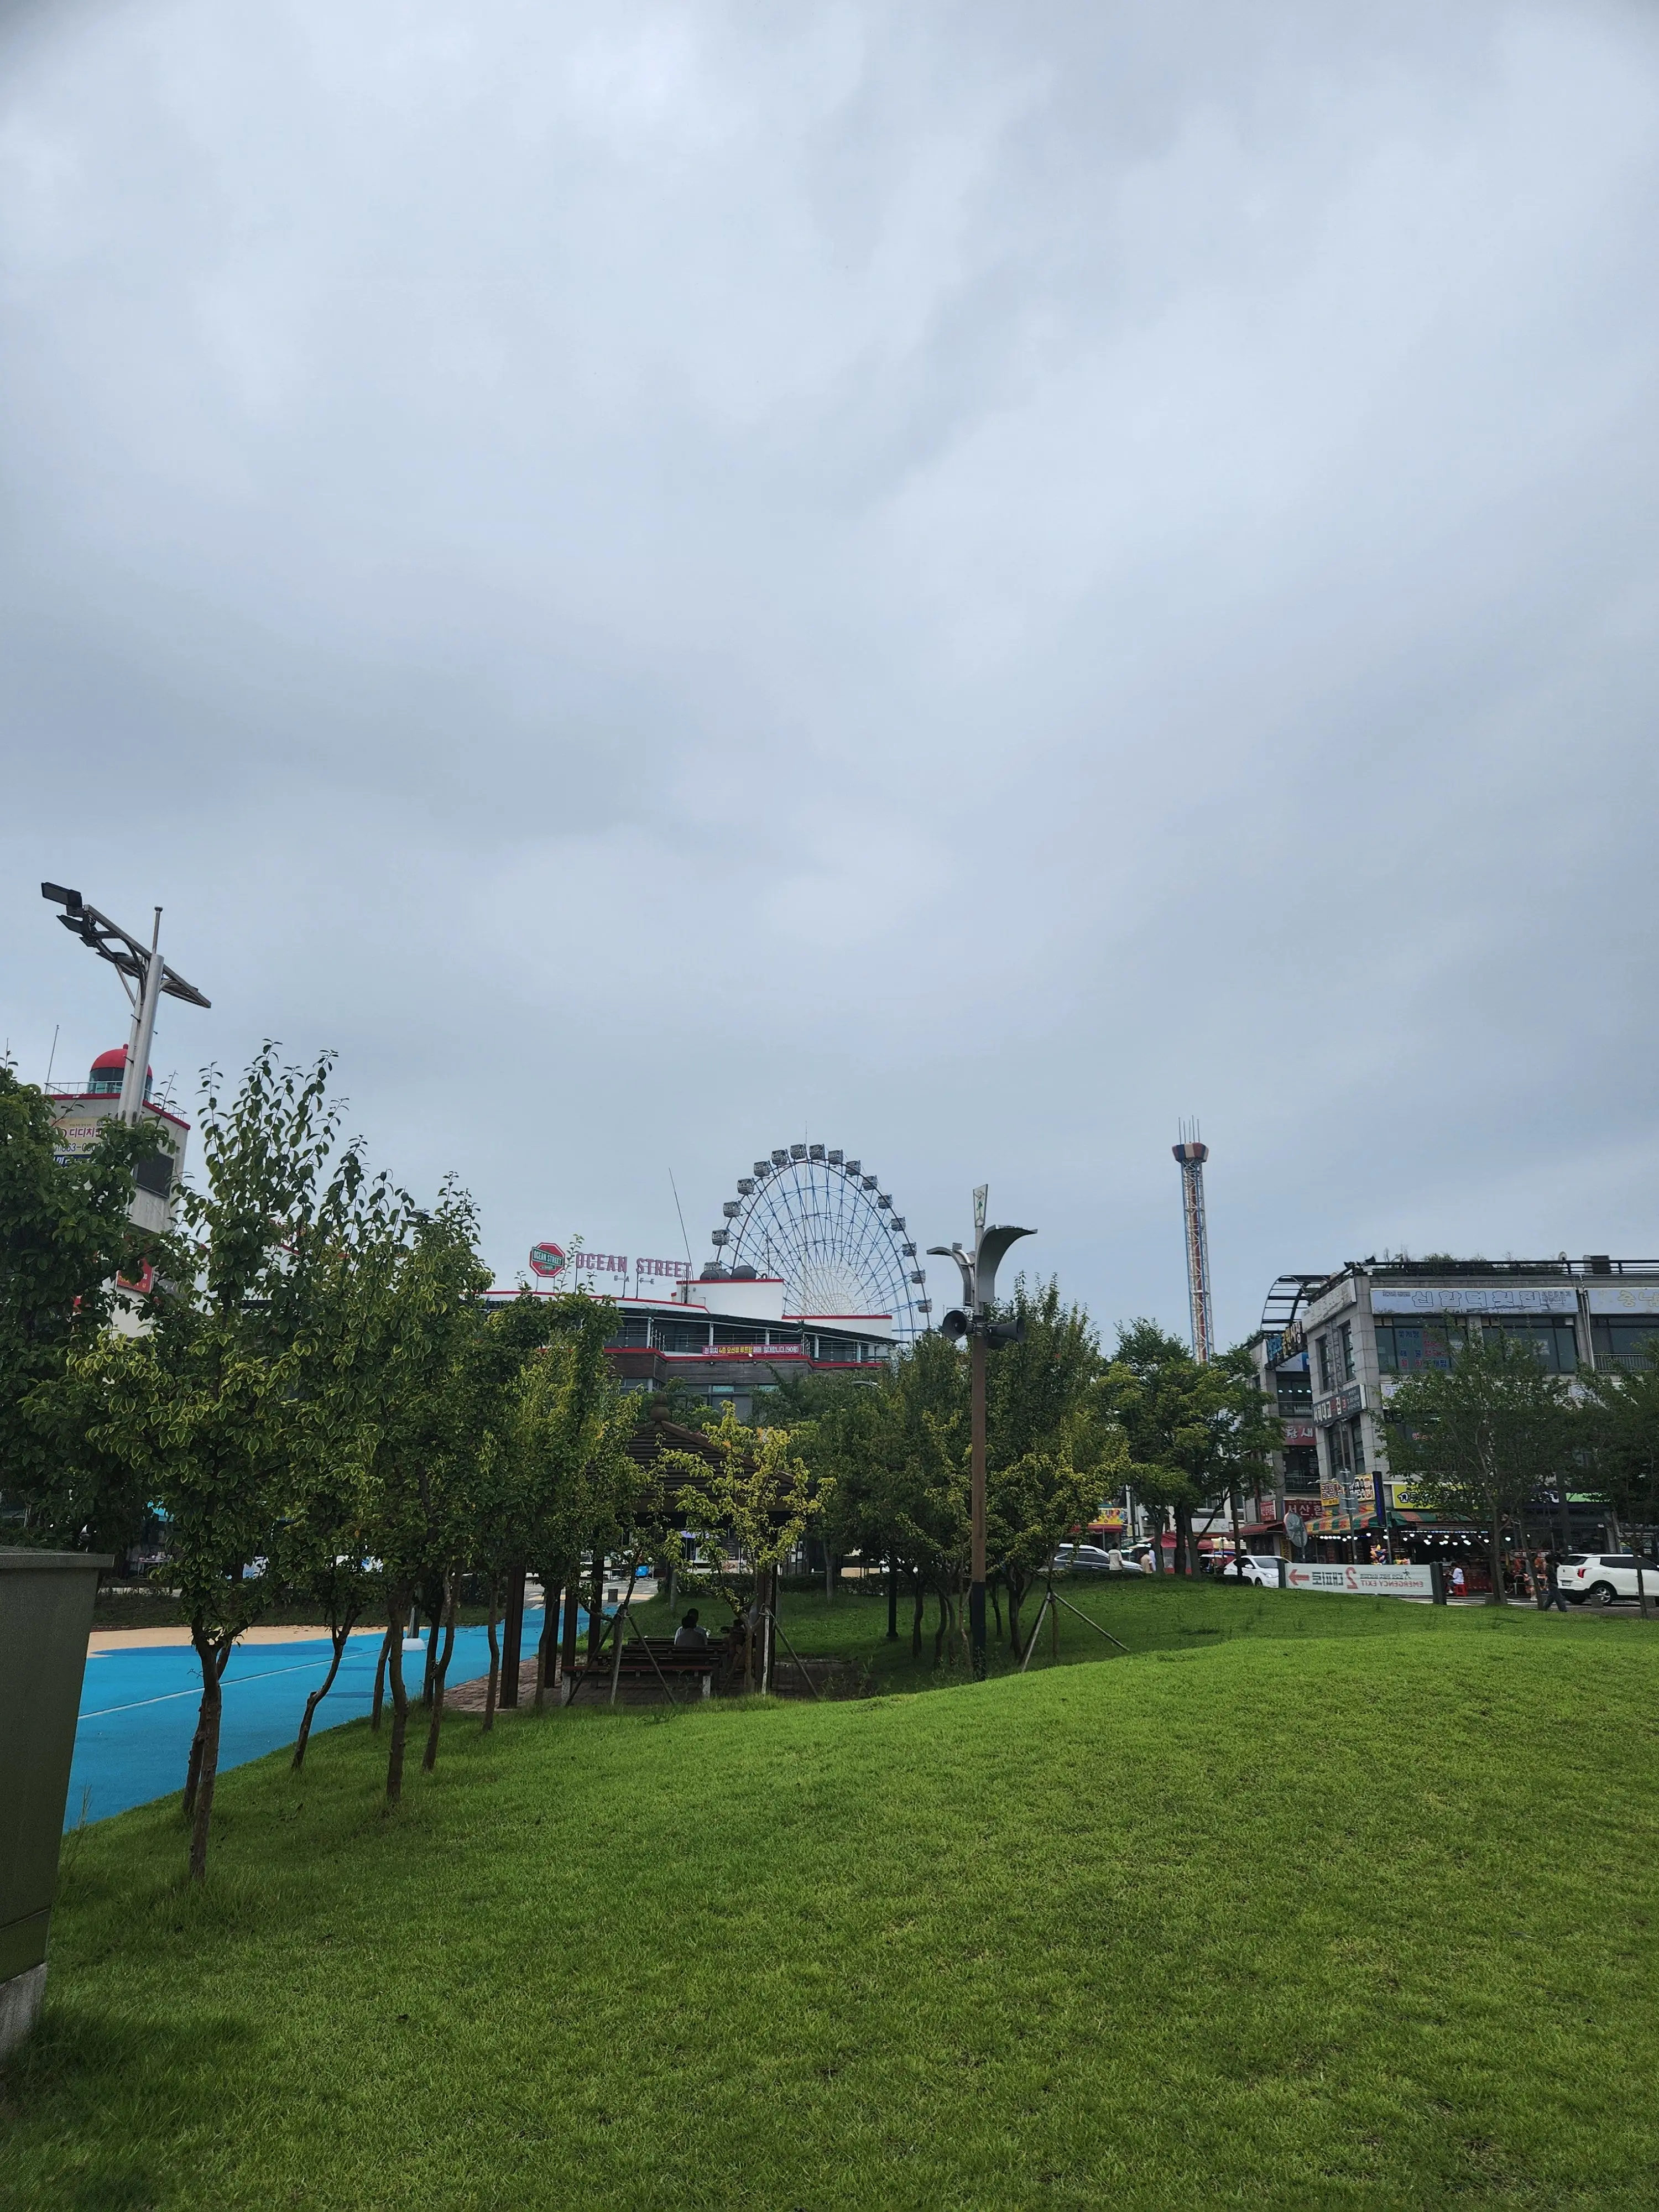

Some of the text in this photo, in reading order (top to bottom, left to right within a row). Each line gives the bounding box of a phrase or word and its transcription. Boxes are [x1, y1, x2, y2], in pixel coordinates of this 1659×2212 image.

[547, 1254, 562, 1265] STREET
[576, 1252, 692, 1278] OCEAN STREET
